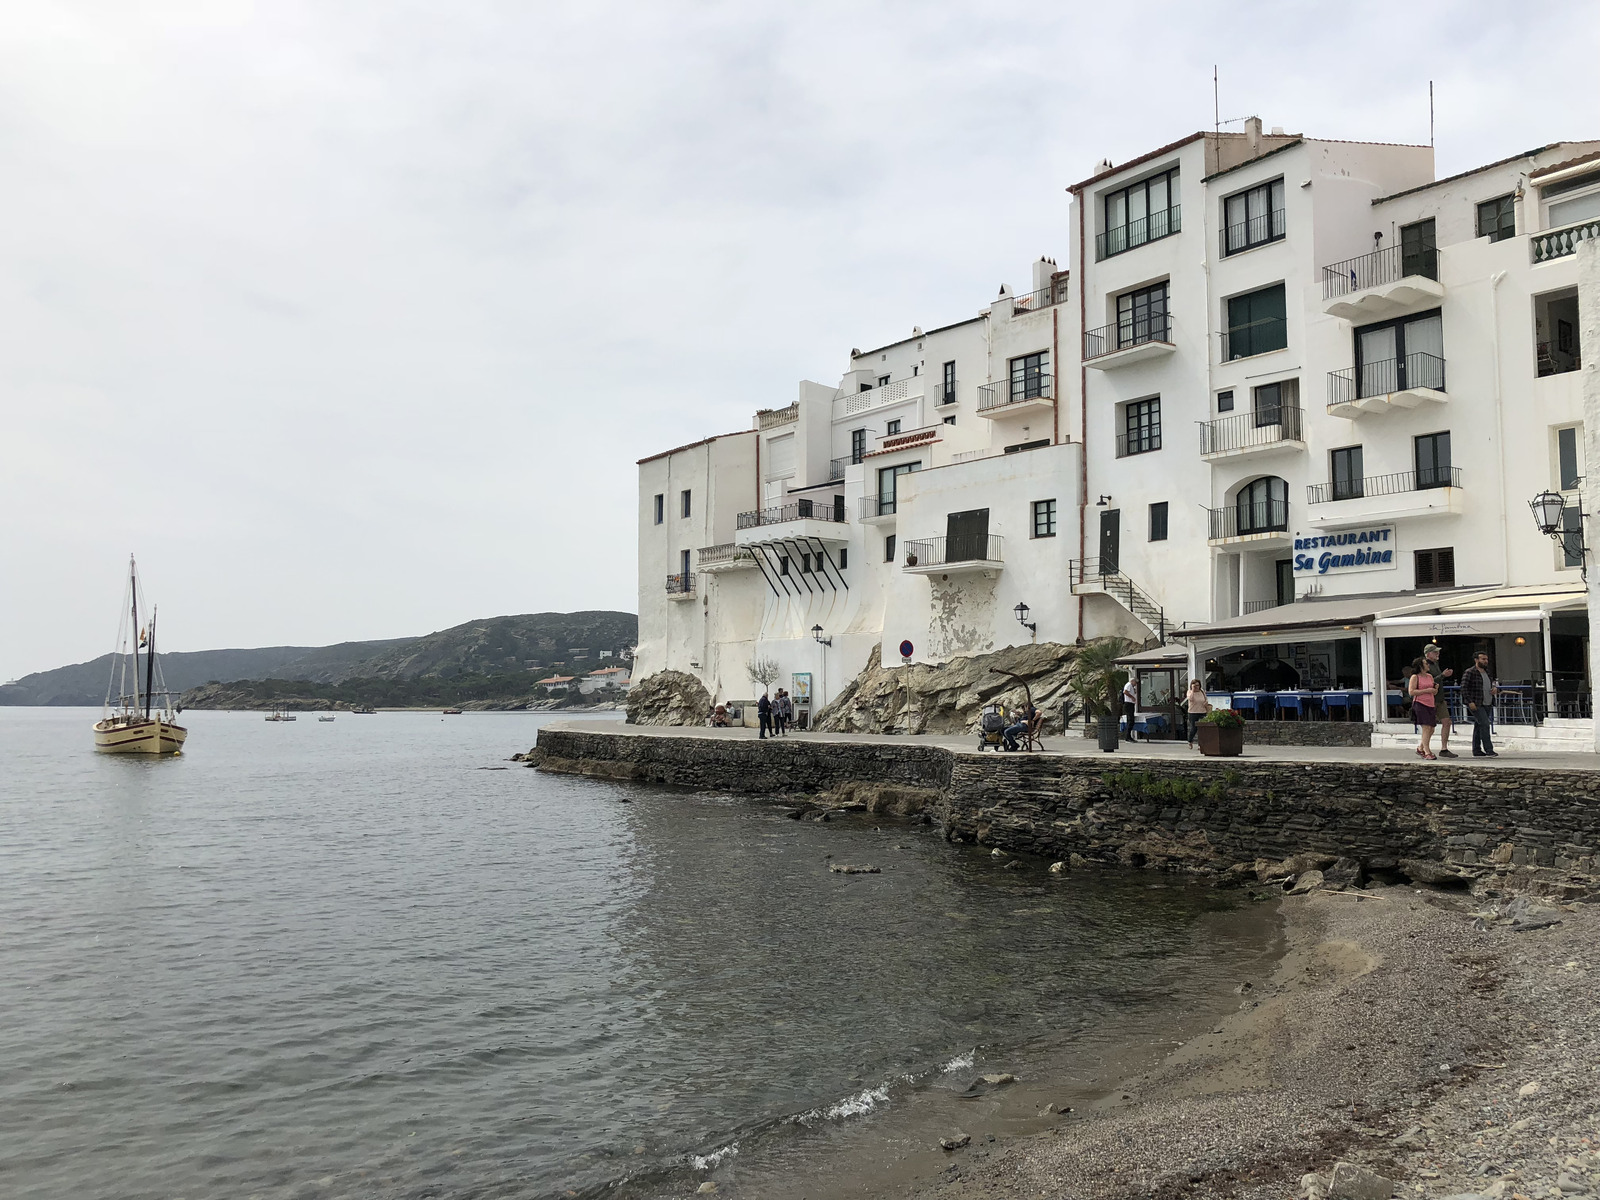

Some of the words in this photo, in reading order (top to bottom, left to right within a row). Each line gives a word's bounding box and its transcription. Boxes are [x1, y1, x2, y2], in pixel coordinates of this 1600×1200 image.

[1294, 529, 1391, 550] RESTAURANT
[1294, 554, 1314, 571] Sa
[1318, 547, 1393, 574] Gambina
